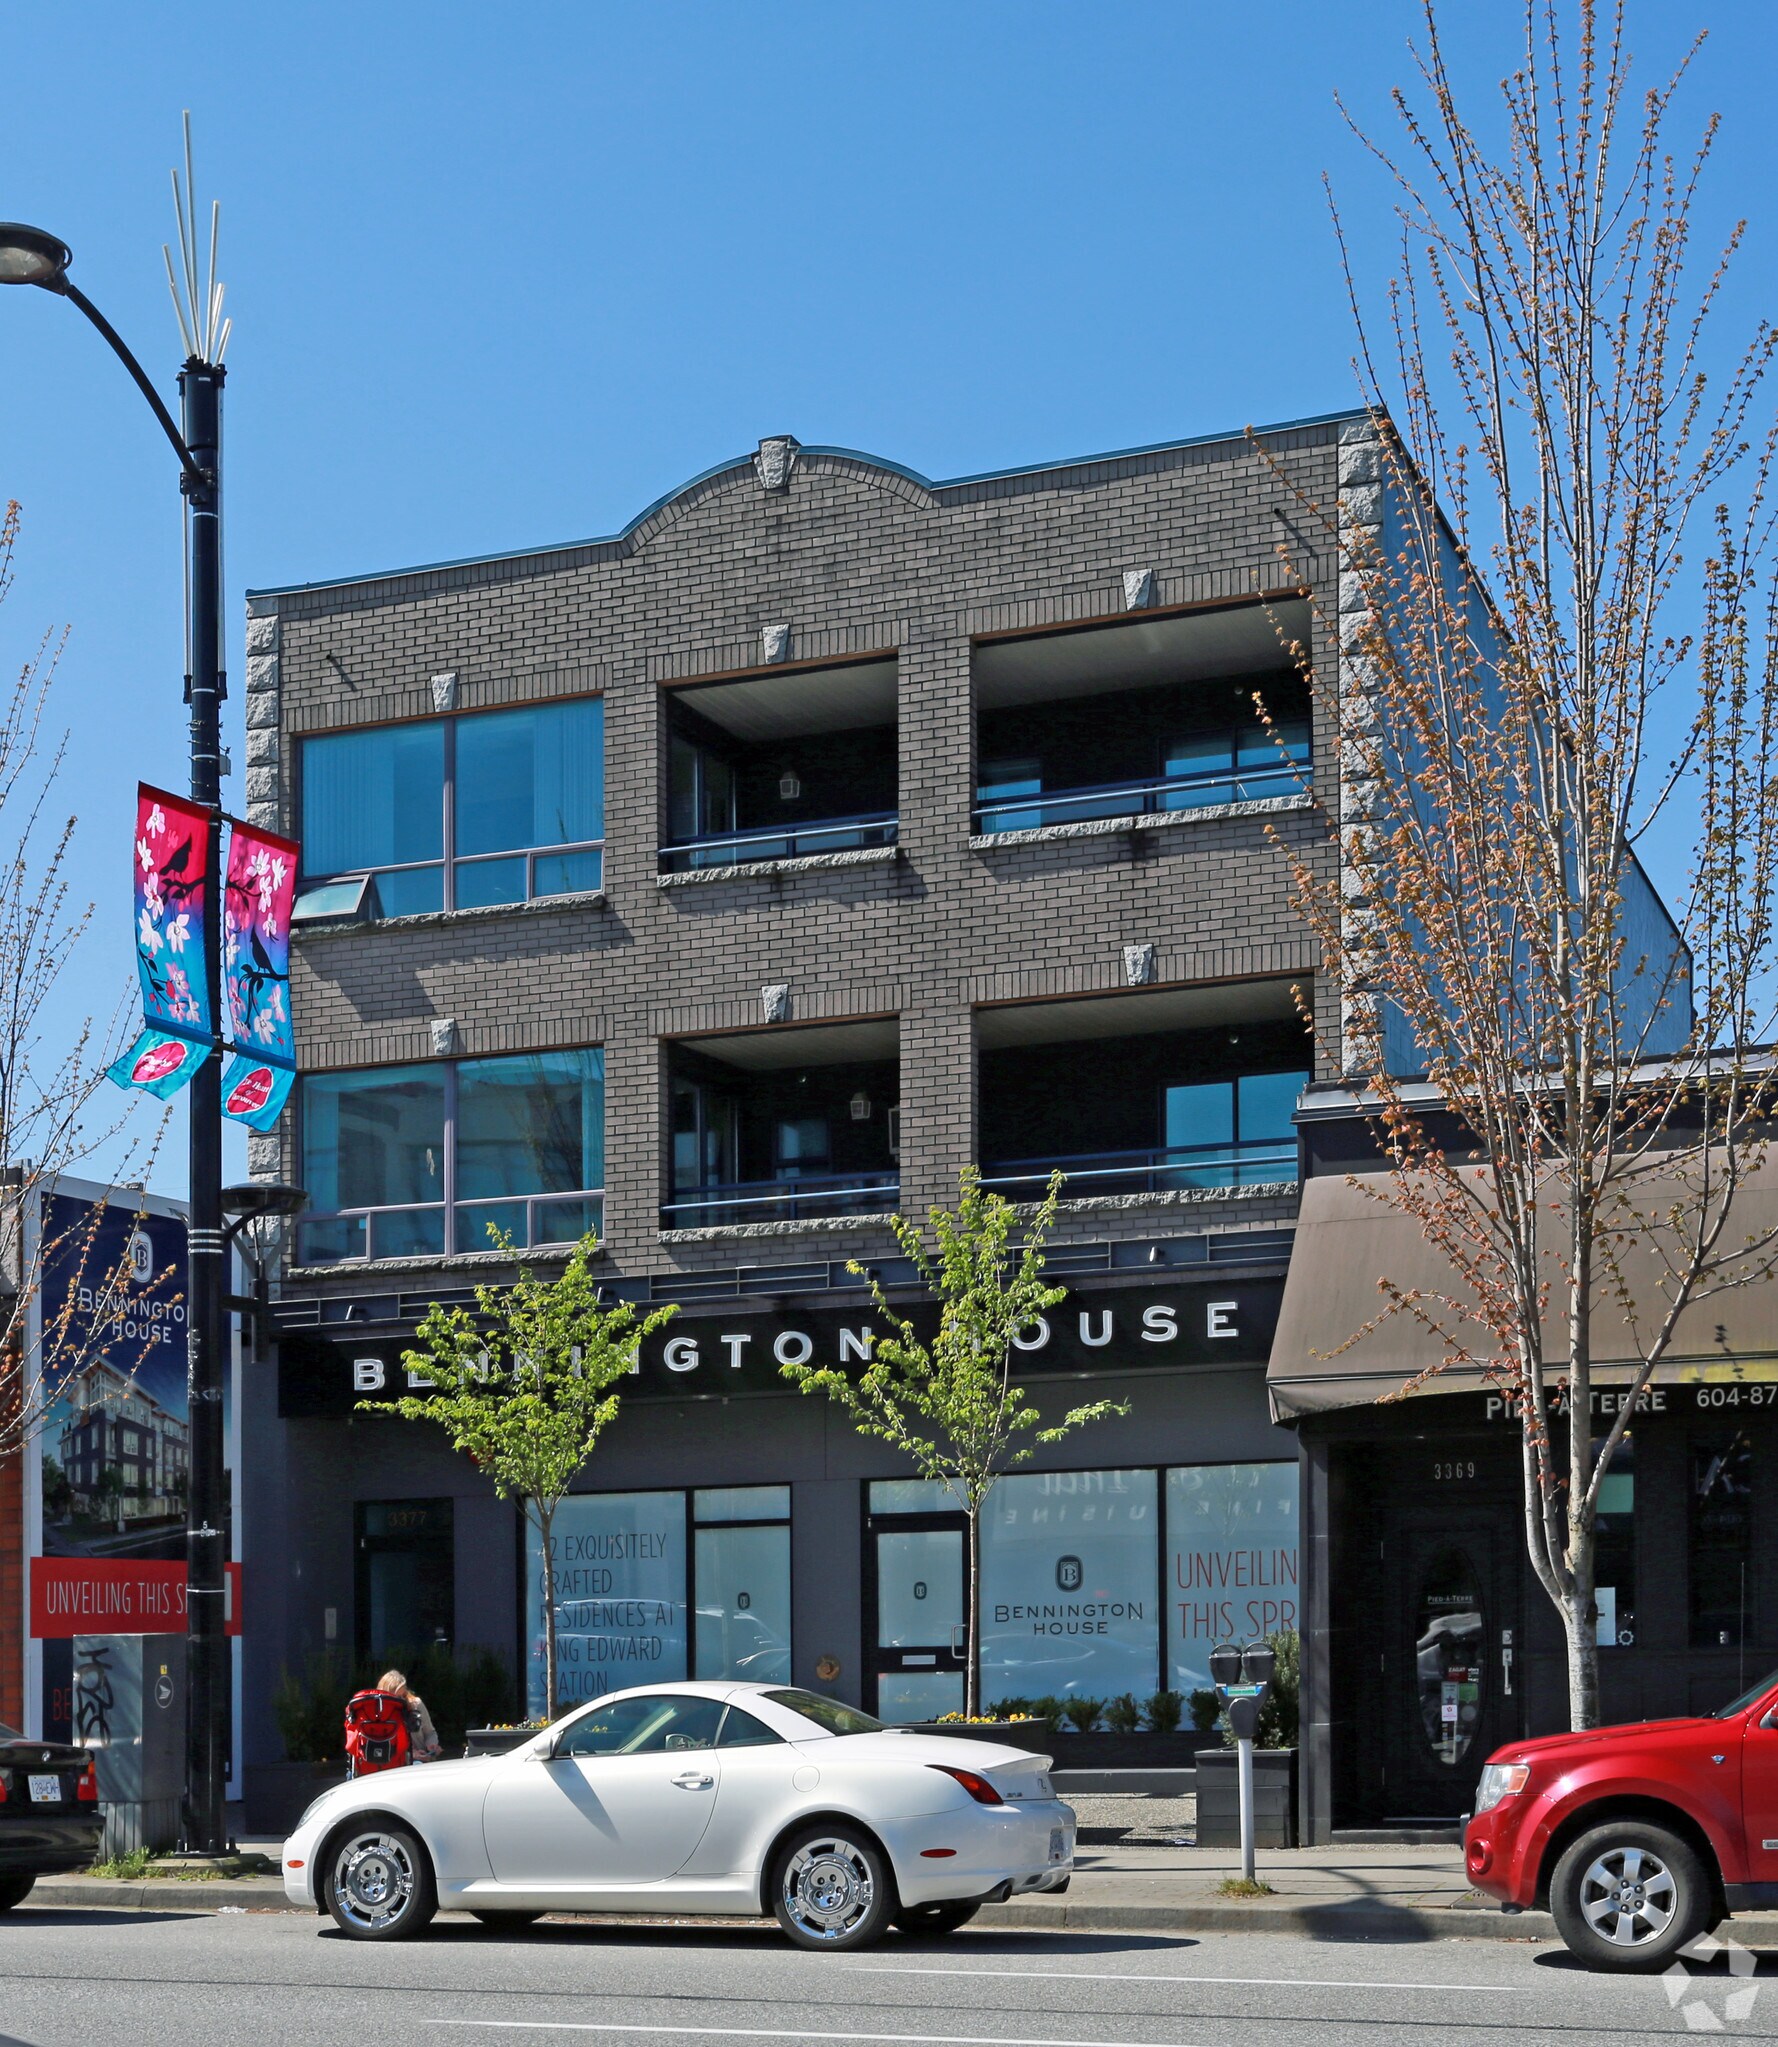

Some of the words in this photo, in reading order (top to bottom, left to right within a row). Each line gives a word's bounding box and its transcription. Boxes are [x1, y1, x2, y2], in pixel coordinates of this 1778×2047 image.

[79, 1287, 190, 1328] BENNINGTO
[112, 1319, 172, 1344] HOUSE
[1696, 1385, 1778, 1408] 604-87
[1434, 1461, 1475, 1480] 3369
[387, 1510, 427, 1528] 3377
[565, 1532, 667, 1561] EXQUISITELY
[1064, 1568, 1077, 1581] B
[47, 1581, 131, 1614] UNVEILING
[138, 1582, 170, 1614] THIS
[994, 1602, 1143, 1623] BENNINGTON
[1177, 1601, 1234, 1639] THIS
[1033, 1621, 1108, 1636] HOUSE
[540, 1637, 579, 1663] KNG
[588, 1636, 662, 1662] EDWARD
[539, 1671, 608, 1697] SATION
